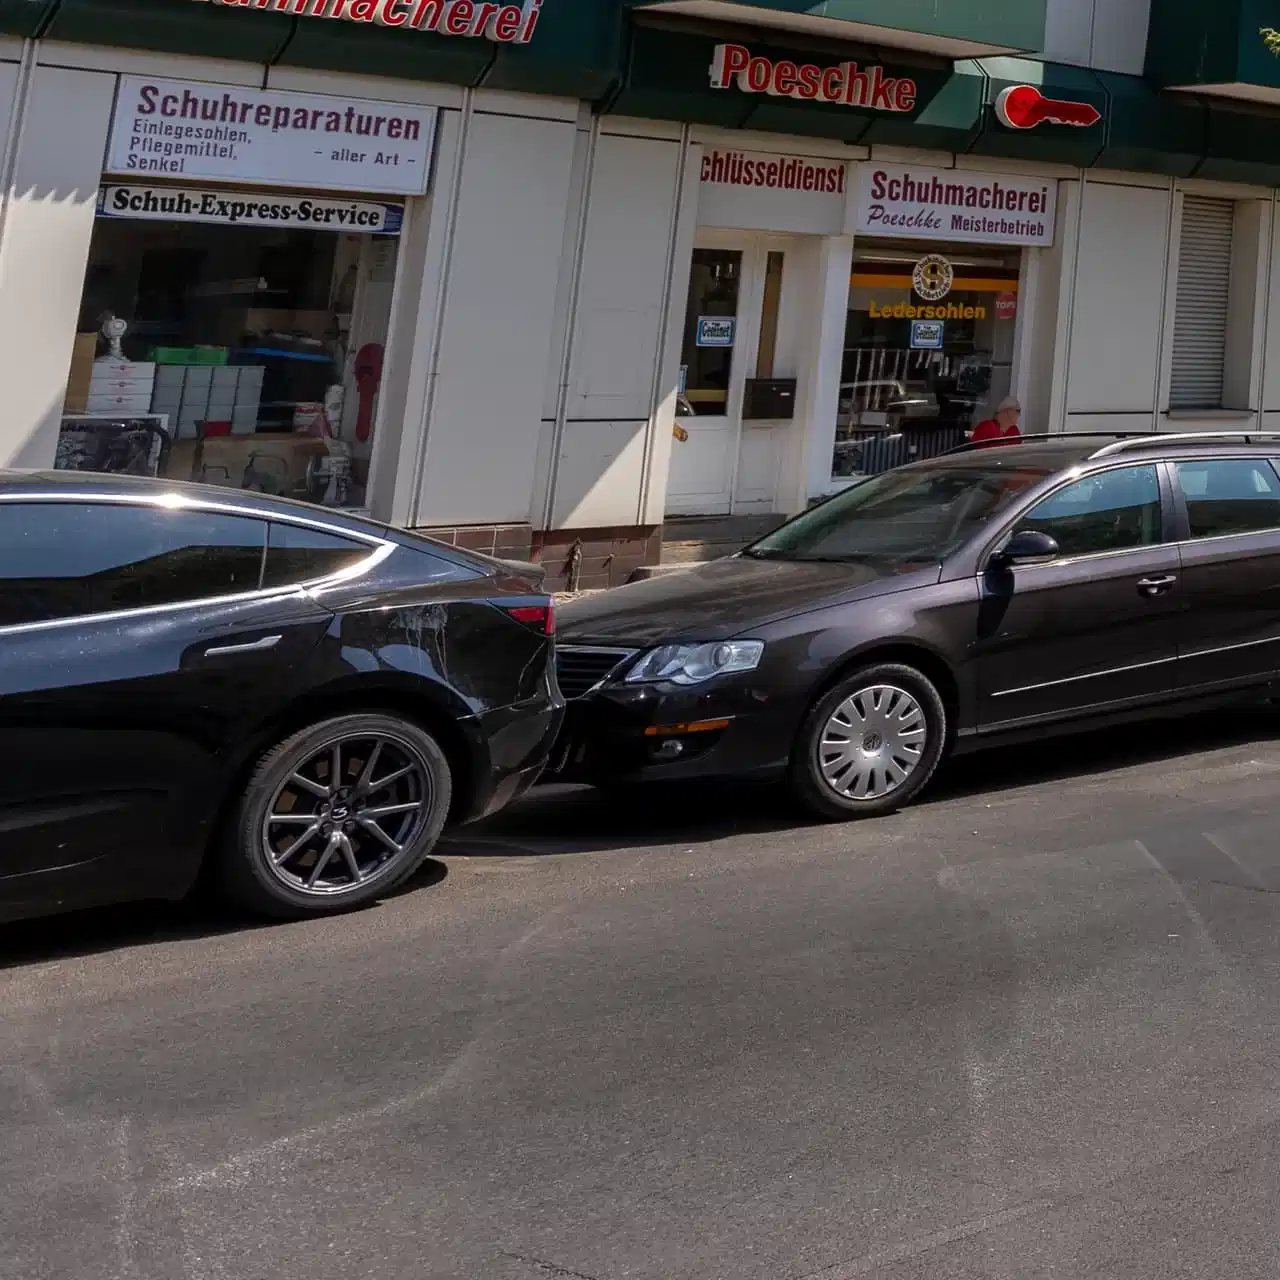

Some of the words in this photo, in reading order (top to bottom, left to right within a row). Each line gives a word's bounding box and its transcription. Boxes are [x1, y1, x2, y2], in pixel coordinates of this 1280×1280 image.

[718, 43, 917, 112] Poeschke
[133, 118, 252, 144] Einlegesohlen,
[137, 86, 420, 141] Schuhreparaturen
[127, 154, 185, 173] Senkel
[331, 149, 366, 164] aller
[374, 152, 399, 167] Art
[701, 150, 844, 193] chlüsseldienst
[113, 188, 380, 227] Schuh-Express-Service
[870, 170, 1048, 213] Schuhmacherei
[866, 204, 942, 229] Poeschke
[951, 214, 1045, 237] Meisterbetrieb
[868, 300, 986, 320] Ledersohlen
